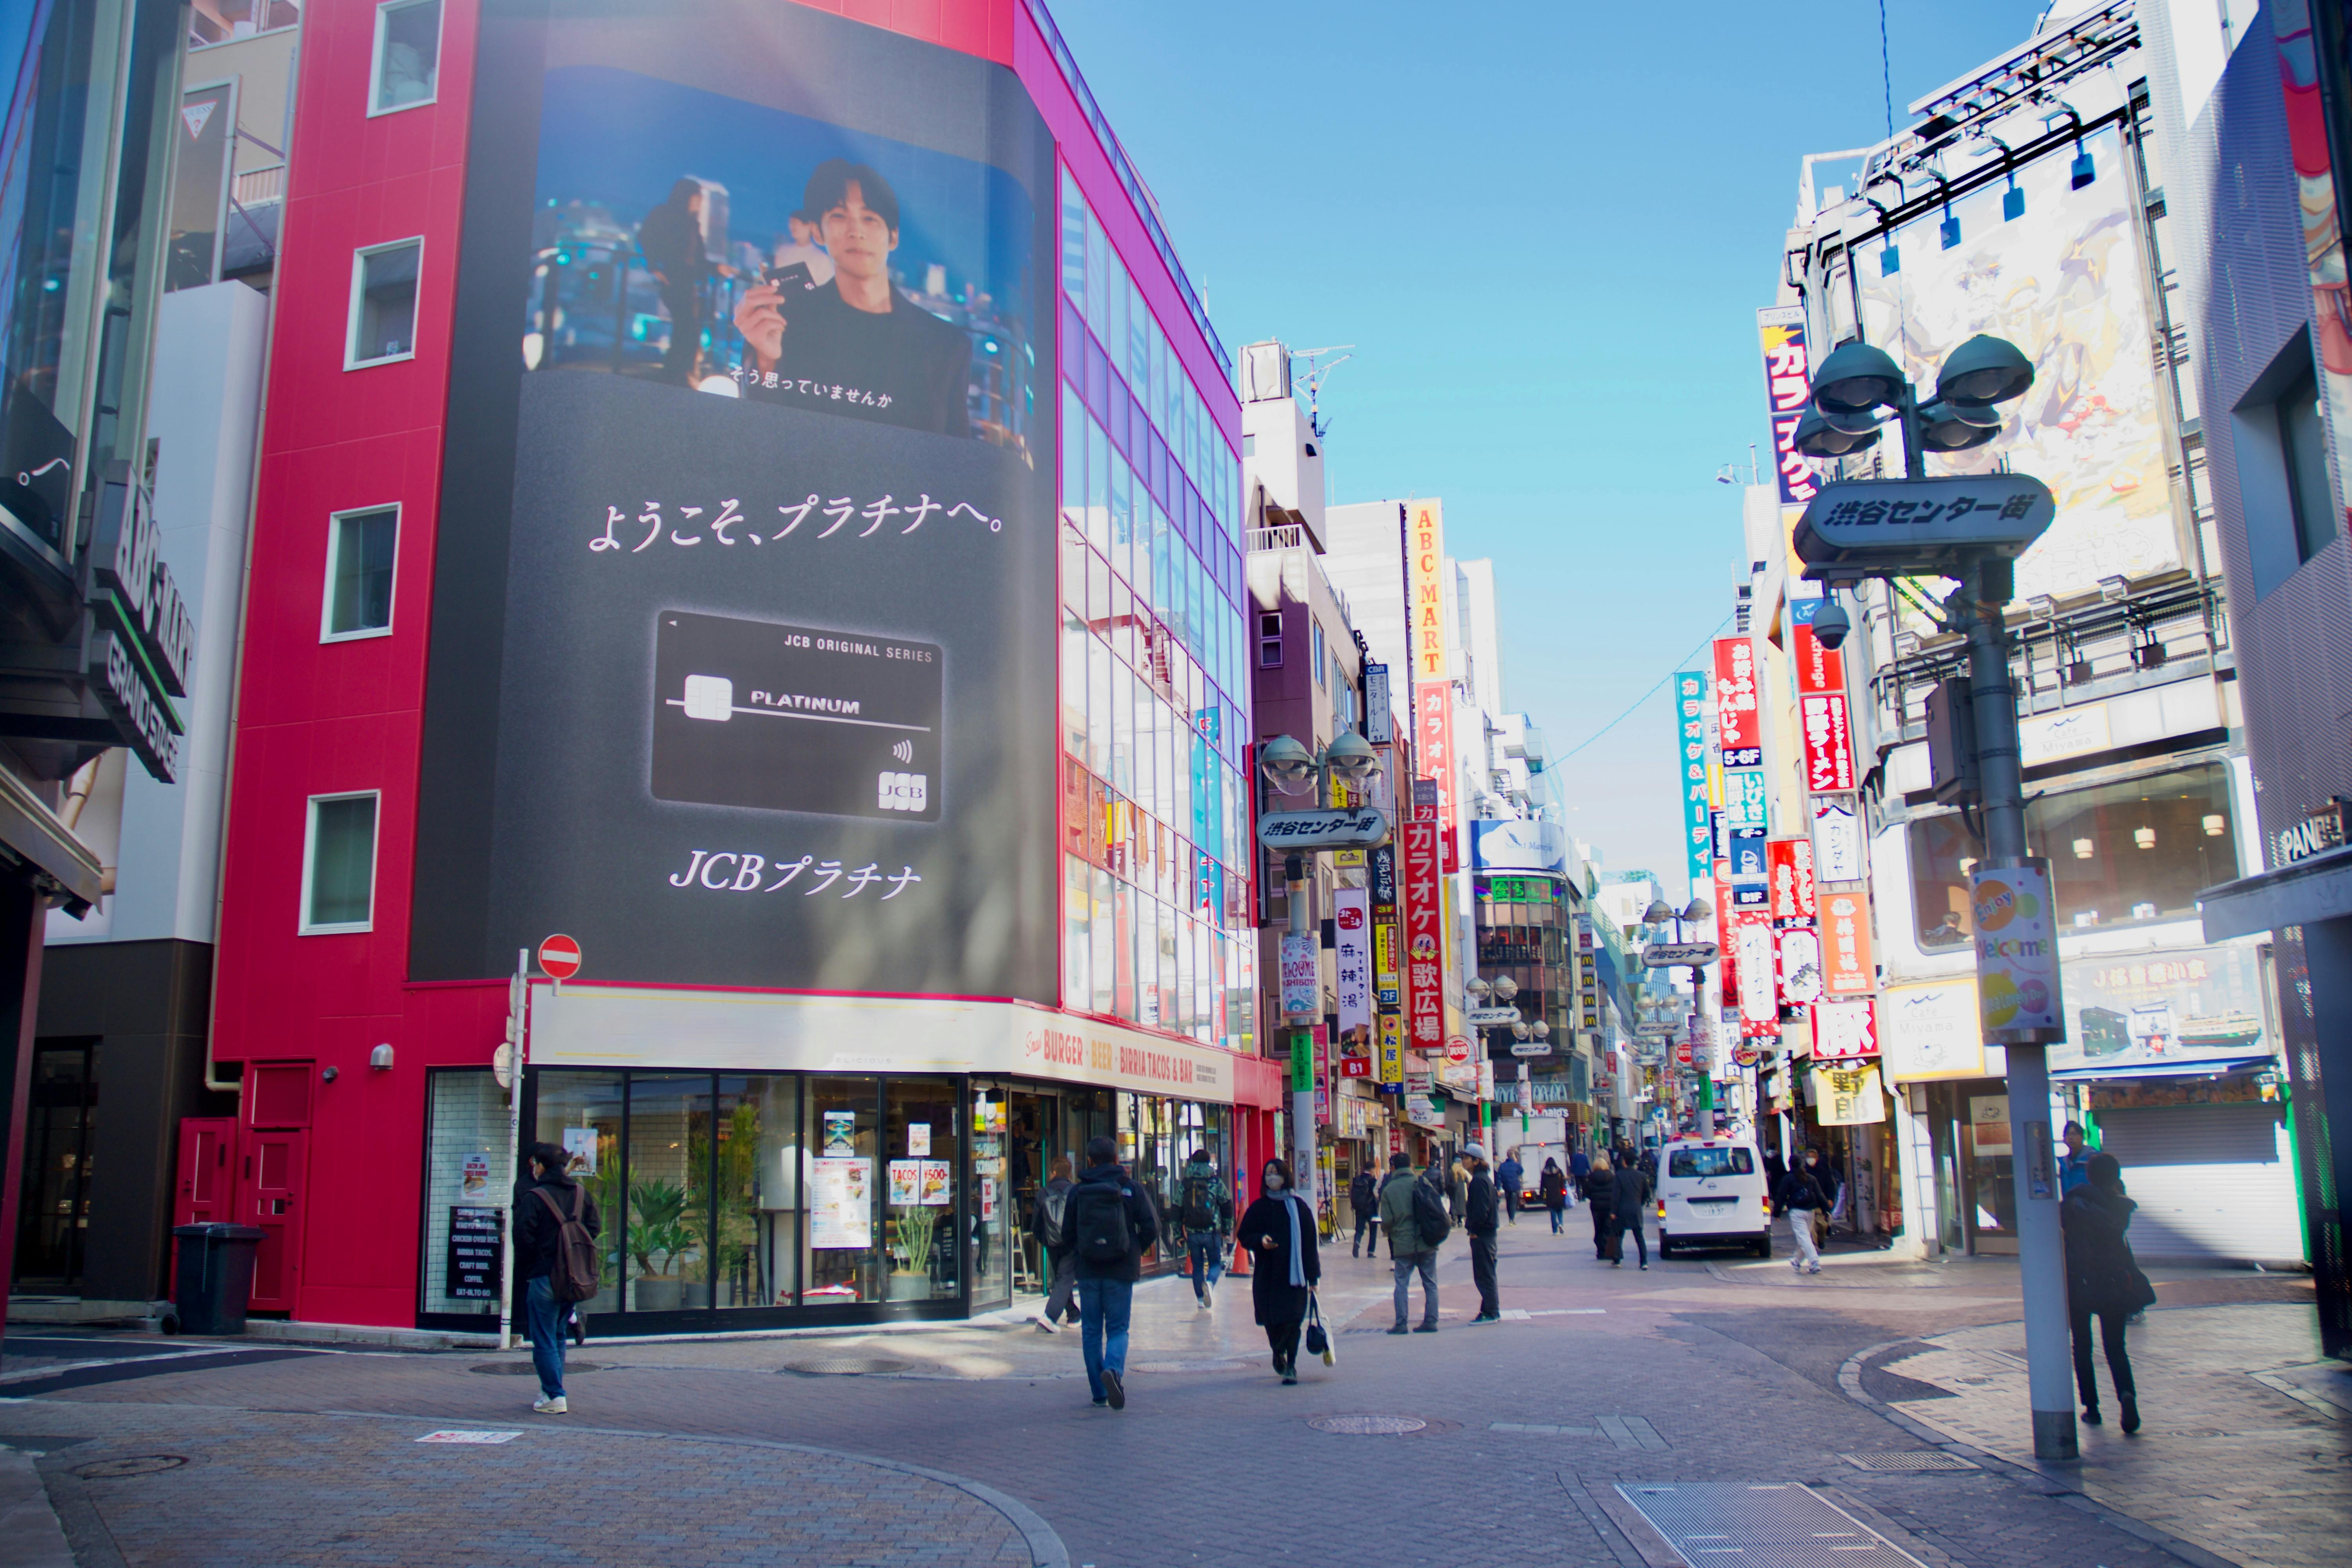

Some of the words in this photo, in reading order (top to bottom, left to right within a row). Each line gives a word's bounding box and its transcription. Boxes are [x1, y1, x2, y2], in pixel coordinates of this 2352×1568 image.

[730, 365, 893, 408] そう思っていませんか
[588, 493, 1002, 554] ようこそ、プラチナへ。
[1824, 494, 2038, 526] 渋谷センター街
[1417, 509, 1439, 673] ABC-MART
[784, 634, 810, 648] JCB
[817, 638, 880, 657] ORIGINAL
[886, 647, 933, 663] SERIES
[750, 690, 860, 715] PLATINUM
[1369, 676, 1379, 733] モニタールーム
[1718, 678, 1741, 744] もんじゃ
[878, 785, 923, 799] JCB
[1745, 773, 1764, 821] いびき
[1264, 816, 1378, 836] 渋谷センター街
[1739, 828, 1754, 838] 4F
[668, 849, 922, 900] JCBプラチナ
[1408, 824, 1436, 931] カラオケ
[1740, 892, 1762, 903] B1F
[1974, 891, 2012, 924] Enjoy
[1647, 947, 1716, 960] 渋谷センター街
[1341, 943, 1357, 1009] 麻辣湯
[1357, 951, 1365, 999] マーラータン
[1382, 991, 1396, 1001] 2F
[1412, 962, 1441, 1043] 歌広場
[1899, 1022, 1954, 1036] Miyama
[1044, 1028, 1083, 1067] BURGER
[1091, 1039, 1112, 1071] BEER
[1120, 1046, 1147, 1077] BIRRIA
[1148, 1053, 1171, 1081] TACOS
[1172, 1060, 1178, 1082] &
[1180, 1059, 1193, 1085] BAR
[1384, 1034, 1397, 1061] 松屋
[1349, 1062, 1363, 1074] B1
[1833, 1071, 1869, 1122] 野郎
[892, 1169, 917, 1181] TACOS
